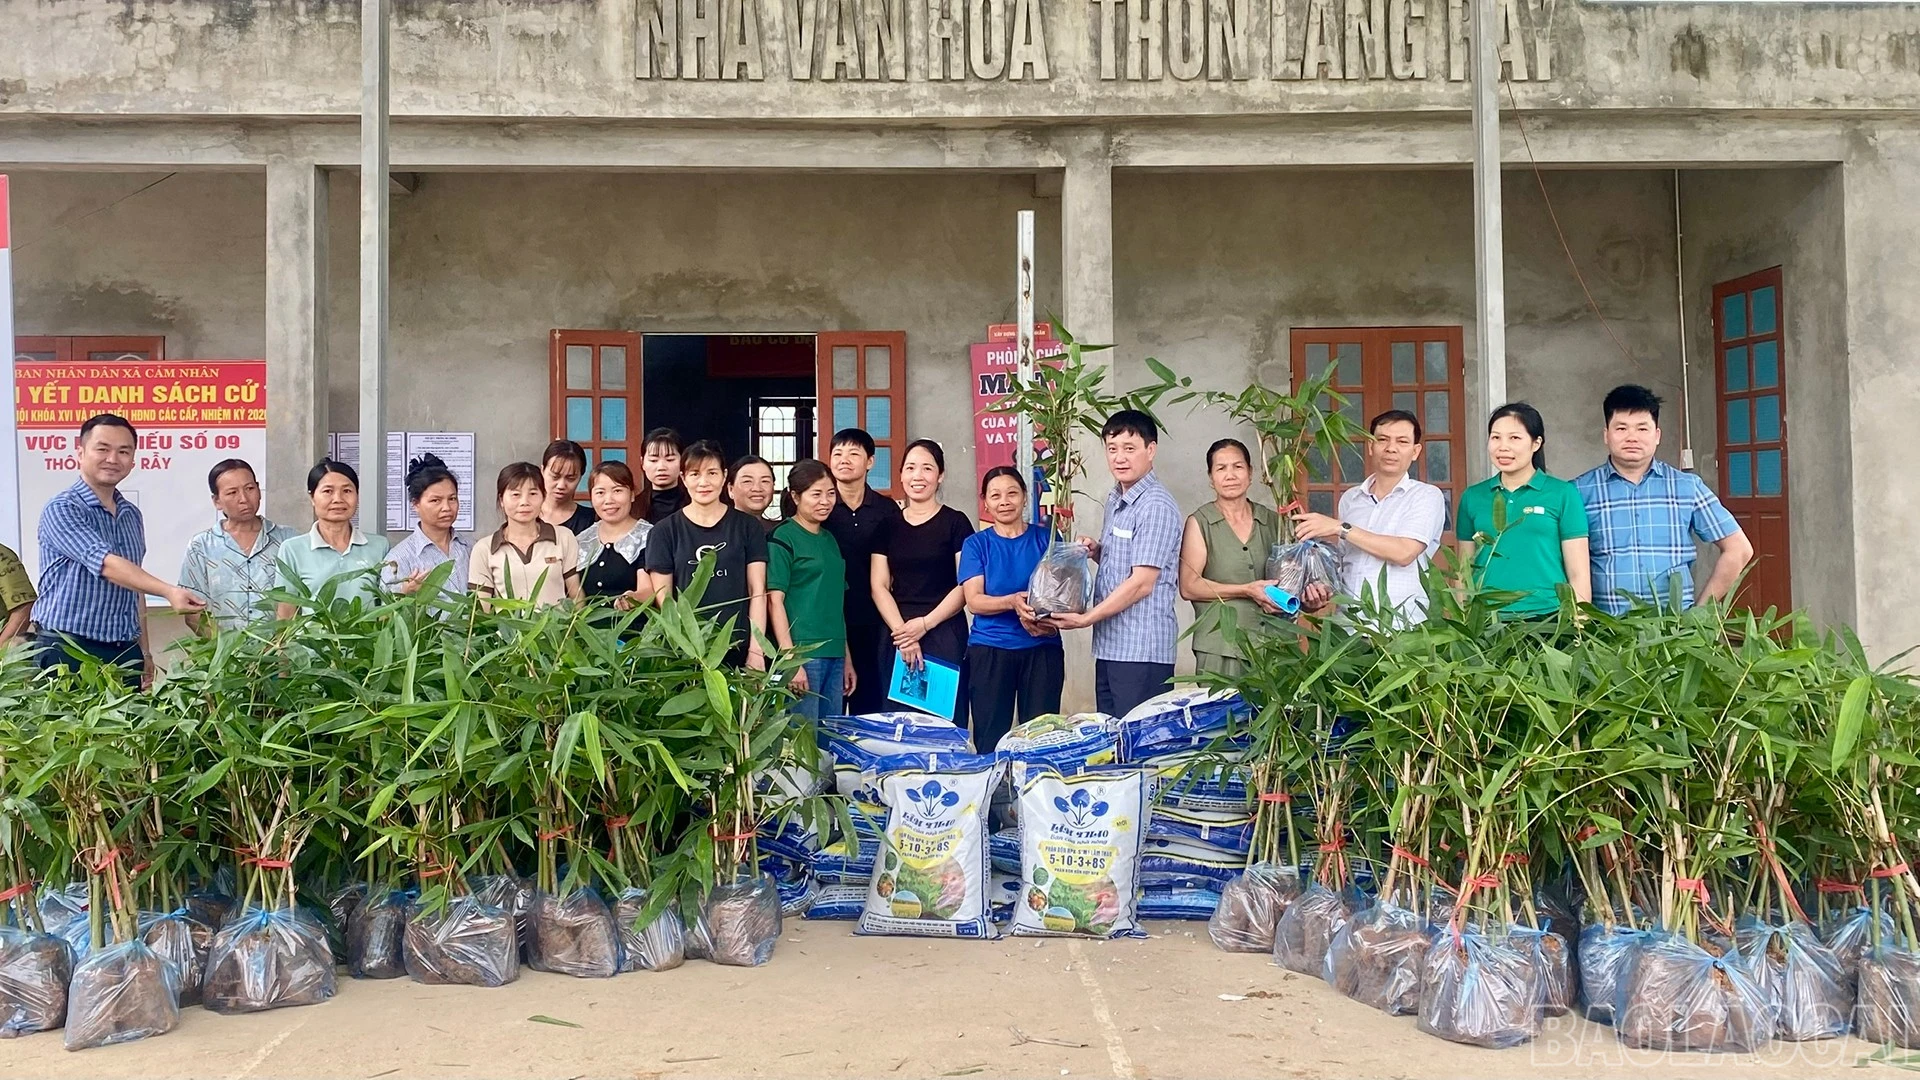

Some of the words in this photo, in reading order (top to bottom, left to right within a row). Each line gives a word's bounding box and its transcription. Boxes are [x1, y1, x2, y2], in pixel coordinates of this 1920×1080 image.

[987, 346, 1018, 366] PHÒ
[46, 366, 87, 379] NHÂN
[90, 366, 120, 379] DÂN
[122, 366, 142, 379] XÃ
[179, 366, 220, 379] NHÂN
[28, 380, 72, 404] YẾT
[78, 385, 145, 404] DANH
[152, 381, 218, 404] SÁCH
[224, 378, 260, 403] CỬ
[31, 407, 56, 422] KHÓA
[58, 409, 73, 422] XVI
[75, 407, 88, 421] VÀ
[158, 407, 178, 421] CÁC
[201, 407, 231, 424] NHIỆM
[233, 406, 246, 421] KỲ
[247, 409, 267, 421] 202
[25, 435, 67, 453] VỰC
[138, 431, 173, 450] IẾU
[180, 430, 208, 450] SỐ
[214, 435, 240, 450] 09
[1049, 854, 1106, 870] 5-10-3+8S
